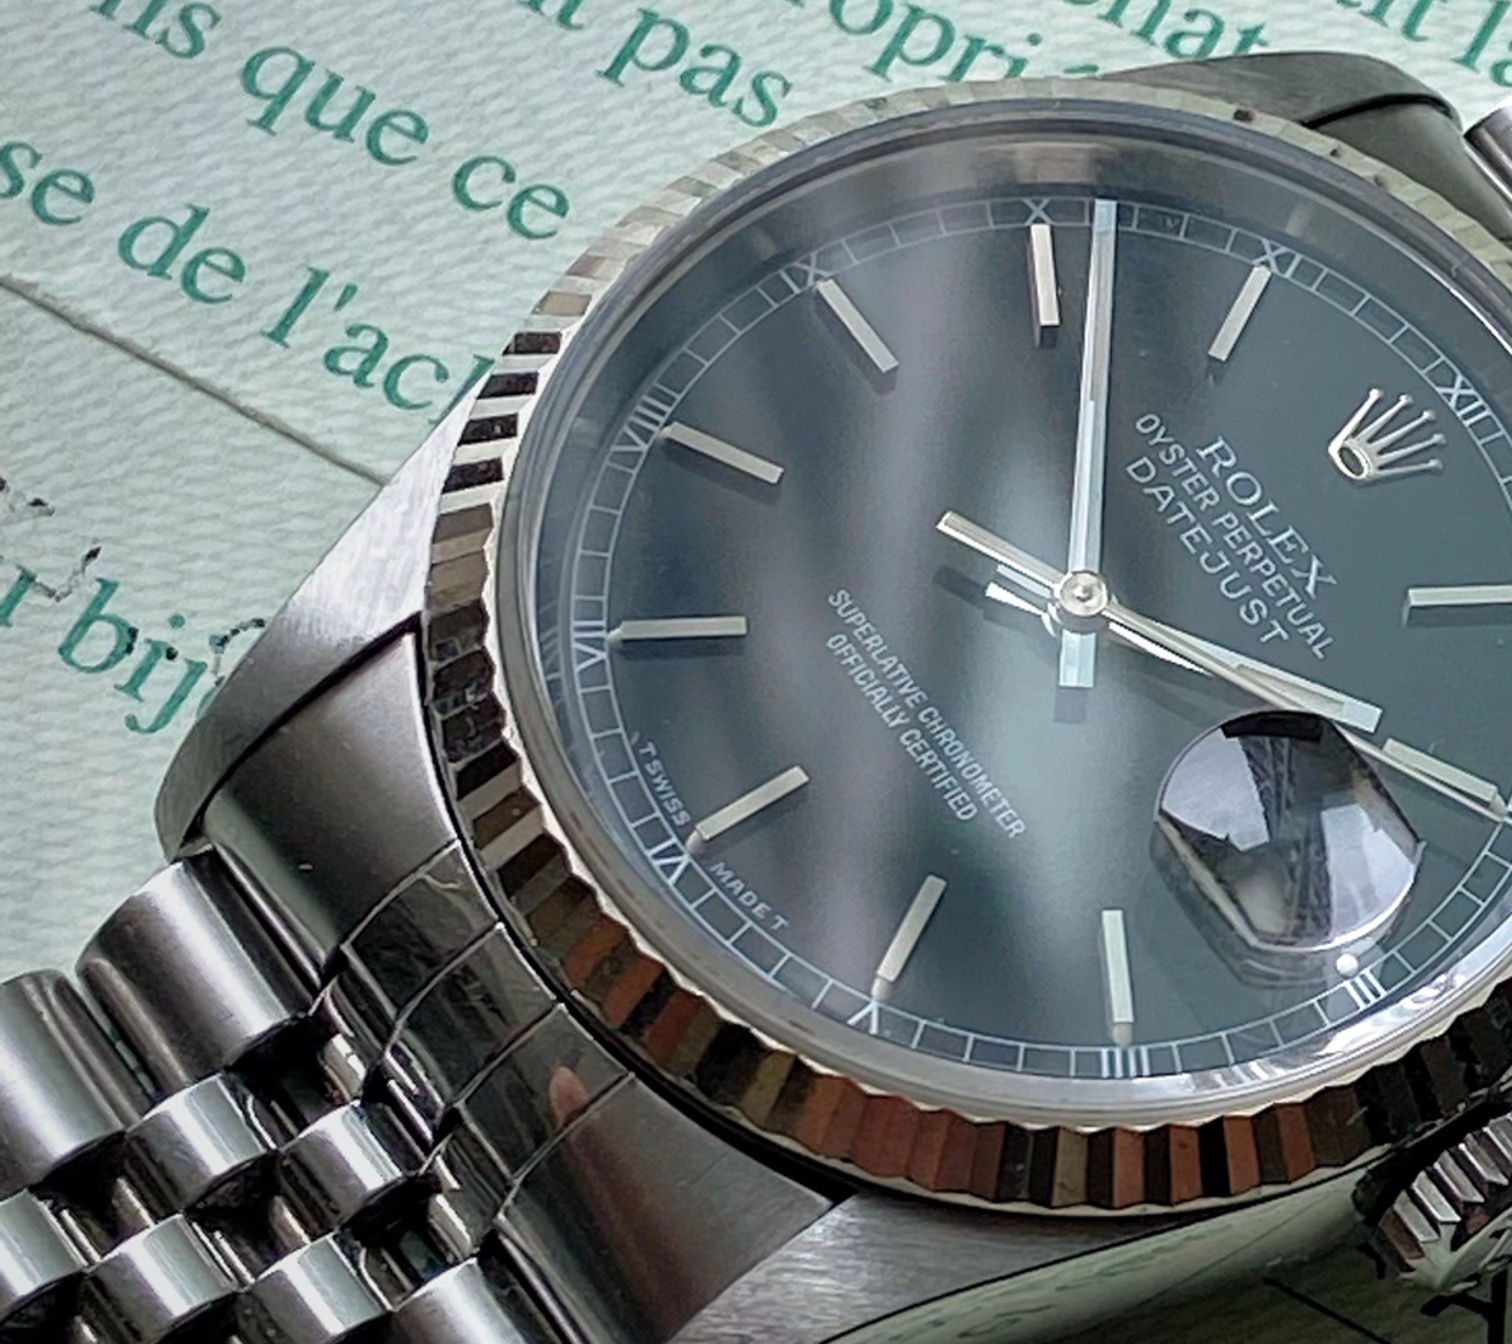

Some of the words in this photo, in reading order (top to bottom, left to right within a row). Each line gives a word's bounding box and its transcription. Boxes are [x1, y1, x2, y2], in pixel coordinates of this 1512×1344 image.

[240, 45, 430, 167] que
[452, 155, 570, 240] ce
[597, 8, 794, 128] pas
[117, 204, 246, 304] de
[1126, 457, 1289, 643] DATEJUST
[1135, 414, 1220, 511] OYSTER
[1212, 512, 1334, 660] PERPETUAL
[1196, 436, 1338, 599] ROLEX
[57, 578, 224, 735] bij
[826, 634, 910, 729] OFFICIALLY
[900, 729, 978, 821] CERTIFIED
[828, 589, 928, 709] SUPERLATIVE
[918, 707, 1026, 839] CHRONOMETER
[644, 759, 692, 826] SWISS
[709, 862, 773, 920] MADE
